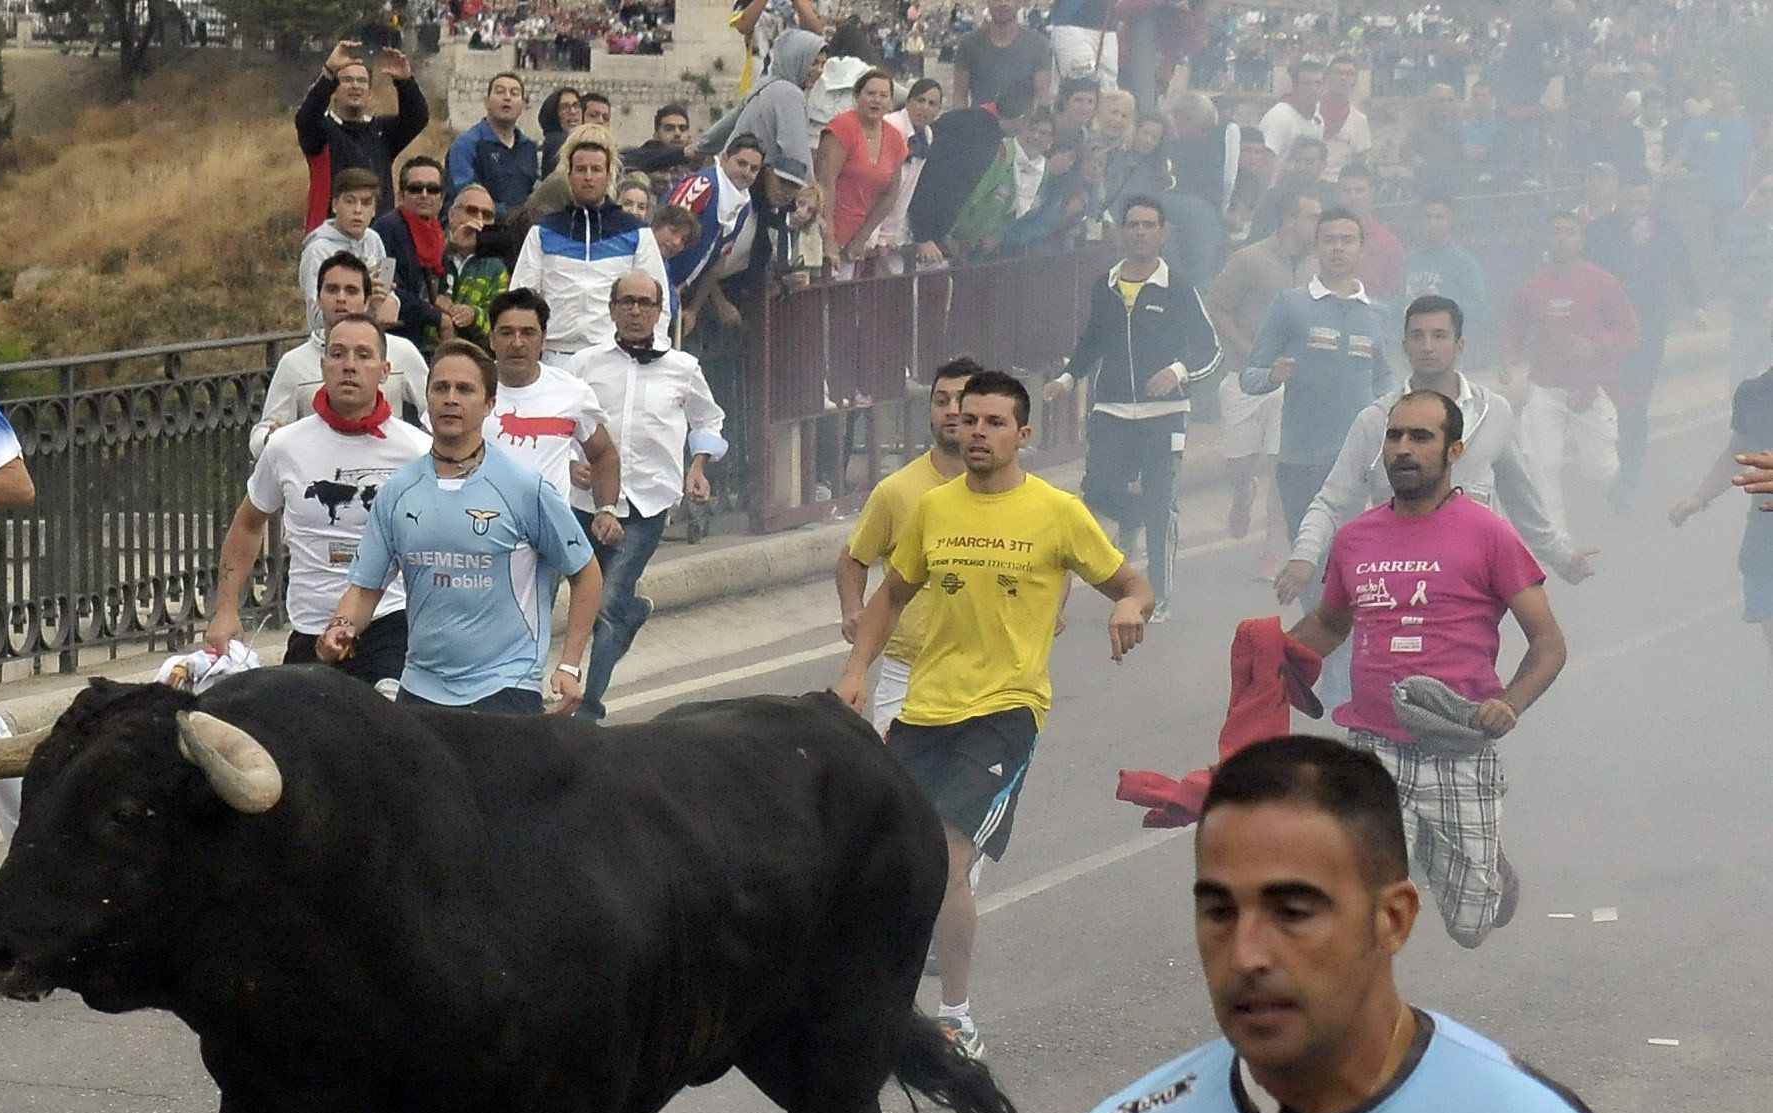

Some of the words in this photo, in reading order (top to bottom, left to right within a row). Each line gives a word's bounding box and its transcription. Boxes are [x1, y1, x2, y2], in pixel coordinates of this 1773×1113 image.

[946, 537, 1005, 549] MARCHA
[404, 551, 493, 569] SIEMENS
[1356, 560, 1442, 574] CARRERA
[433, 571, 493, 589] mobile
